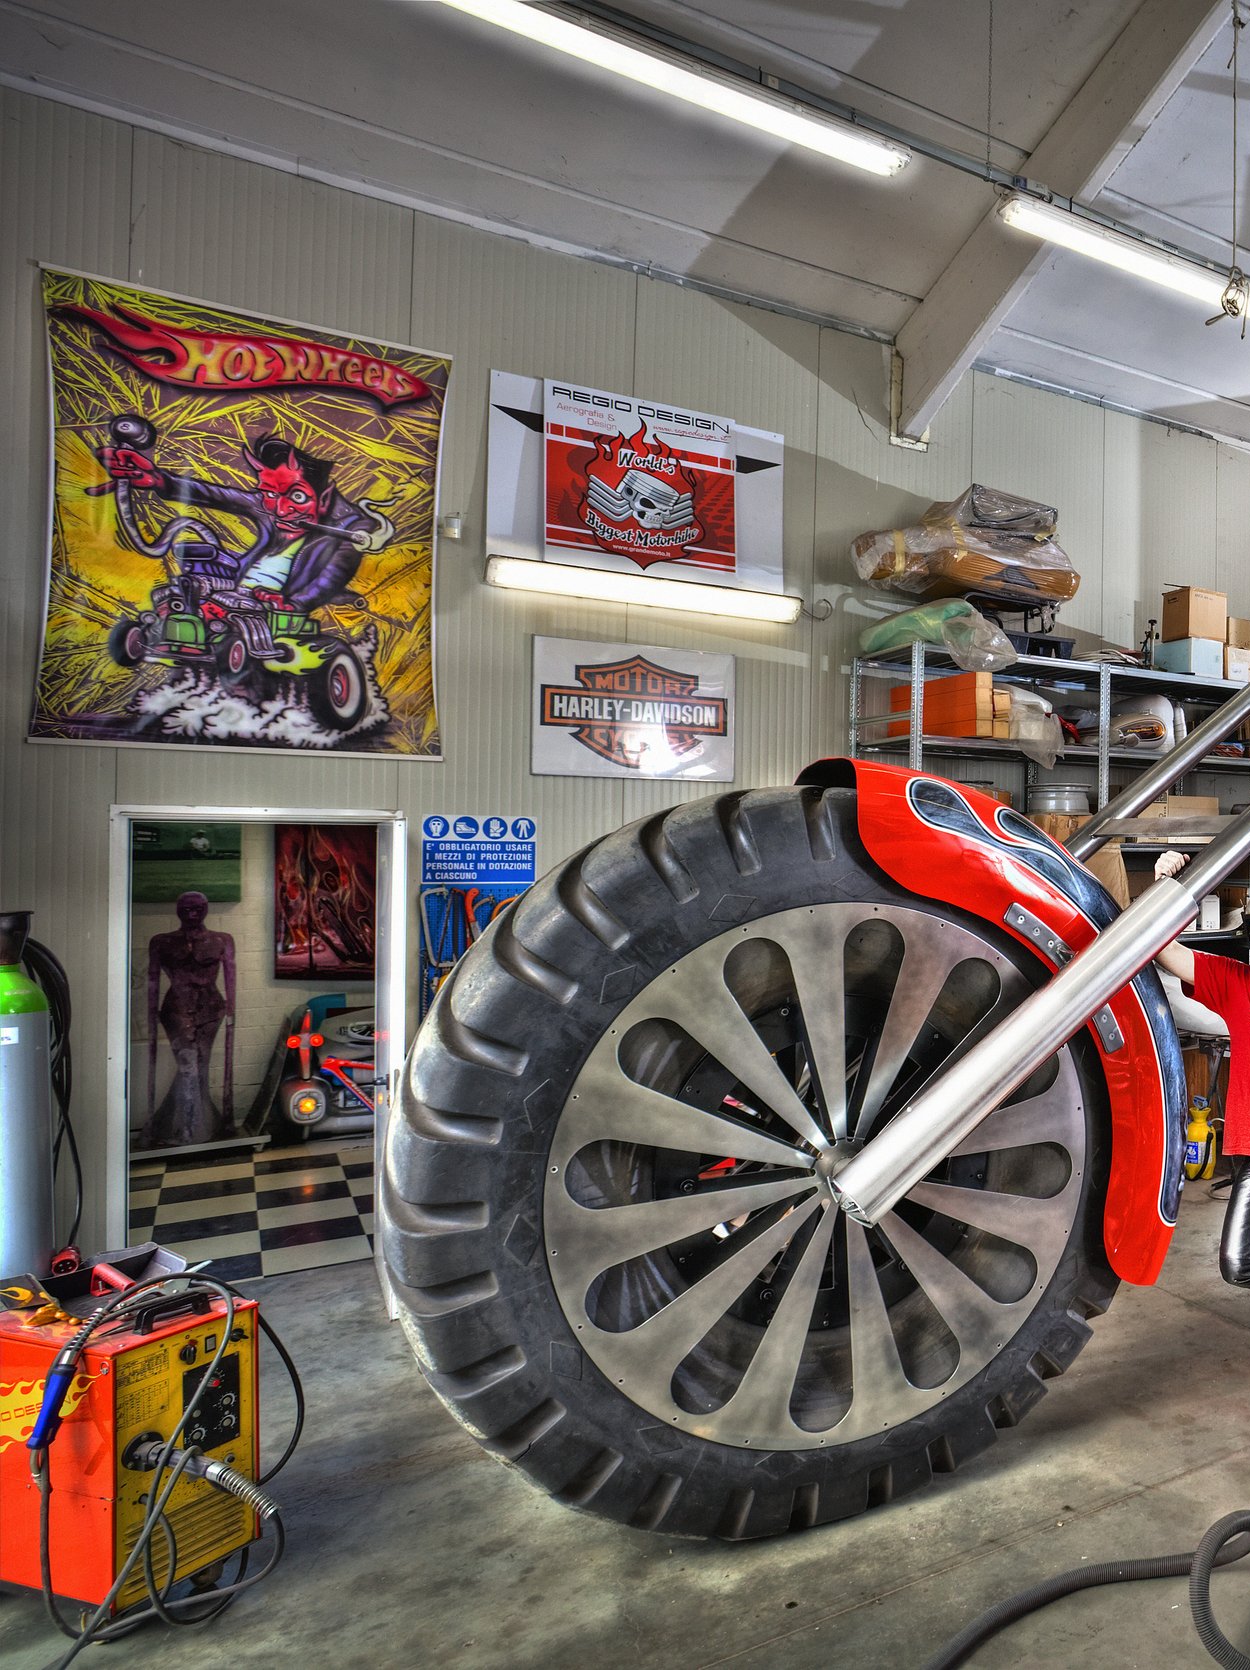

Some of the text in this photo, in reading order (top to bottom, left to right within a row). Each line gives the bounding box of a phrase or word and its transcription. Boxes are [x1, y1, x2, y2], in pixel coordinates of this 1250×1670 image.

[553, 386, 729, 434] REGIO DESIGN
[556, 402, 615, 422] Aerografia &
[587, 417, 617, 431] Design
[618, 450, 675, 474] World's
[586, 510, 699, 548] Biggest Motorbike
[595, 666, 681, 695] MOTOR
[553, 695, 716, 727] HARLEY-DAVIDSON
[440, 843, 501, 851] OBBLIGATORIO
[481, 853, 532, 861] PROTEZIONE
[425, 872, 477, 880] A CIASCUNO
[489, 863, 532, 871] DOTAZIONE
